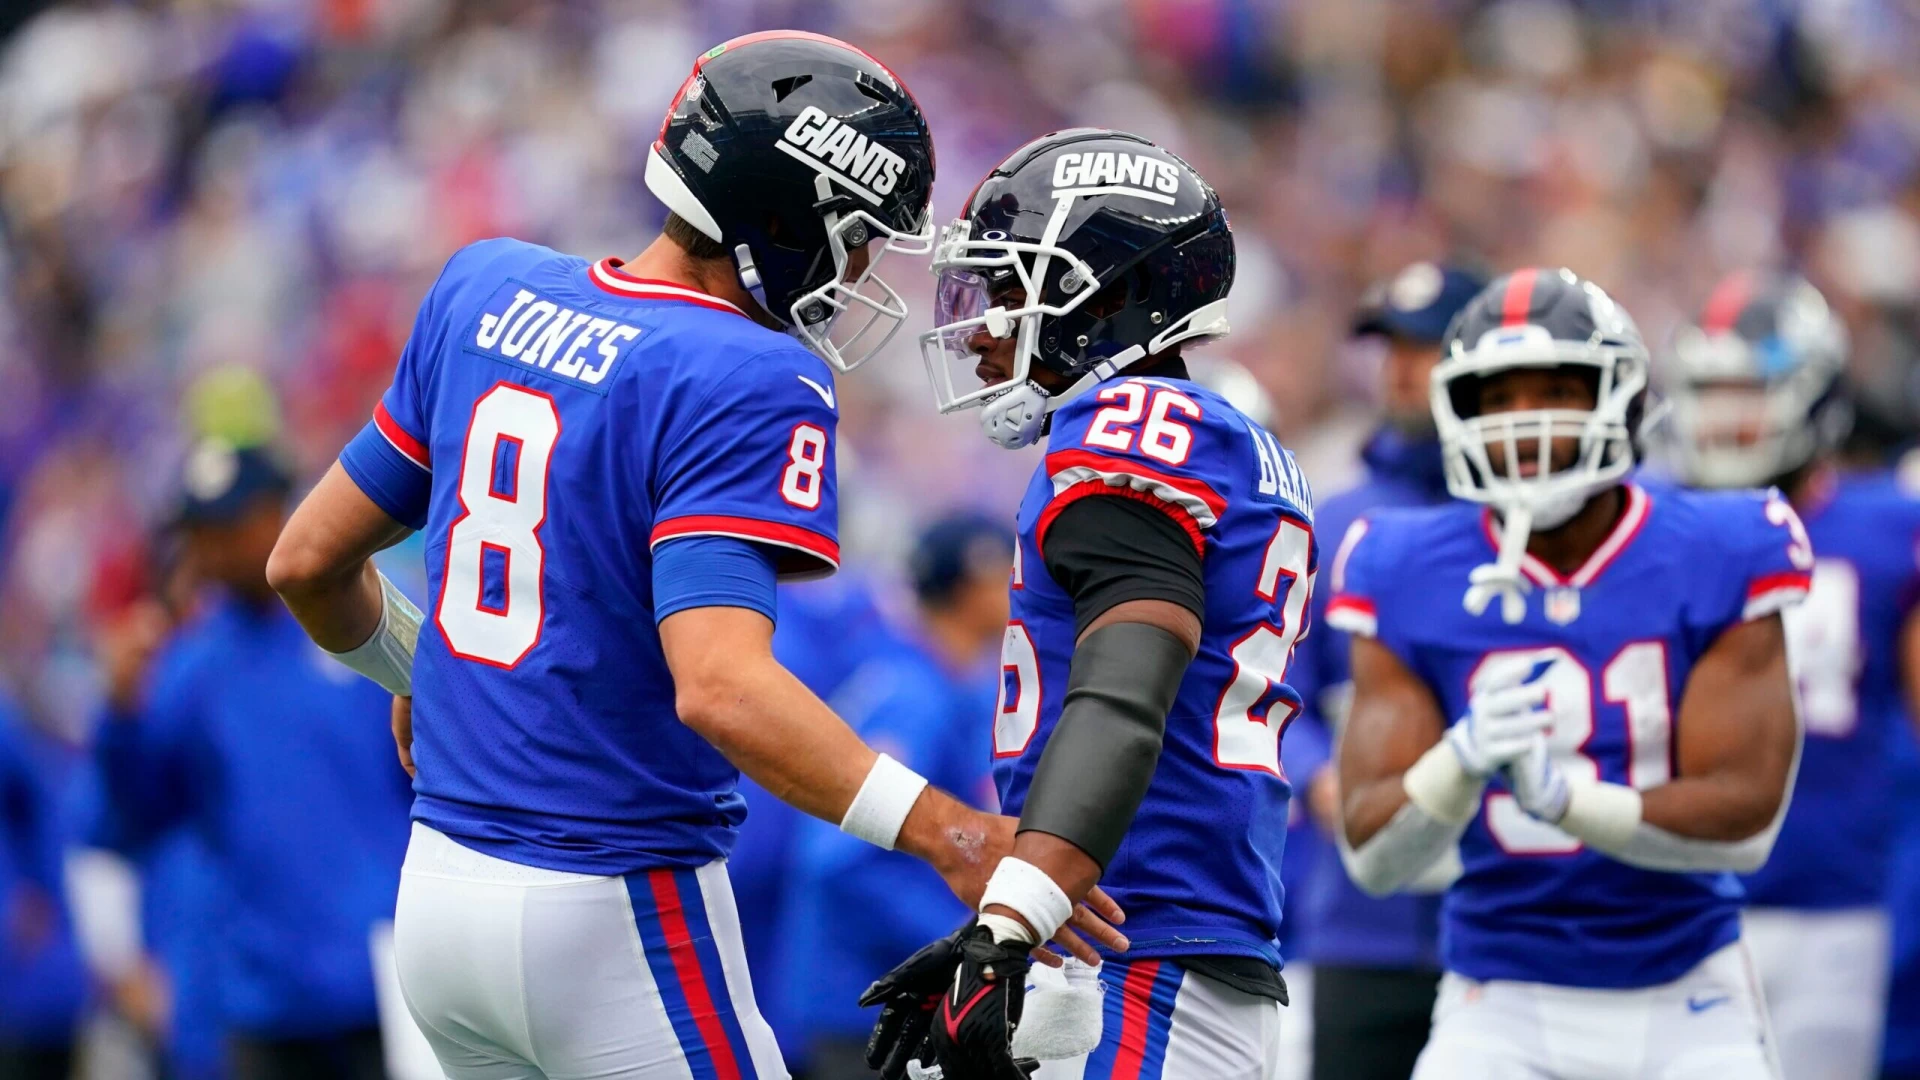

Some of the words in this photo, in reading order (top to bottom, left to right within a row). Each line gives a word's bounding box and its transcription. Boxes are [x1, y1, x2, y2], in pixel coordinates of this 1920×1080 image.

[783, 105, 906, 197] GIANTS
[1052, 152, 1179, 195] GIANTS
[477, 290, 641, 385] JONES
[780, 421, 827, 511] 8
[1083, 380, 1203, 466] 26
[434, 380, 562, 671] 8
[1214, 516, 1319, 782] 2
